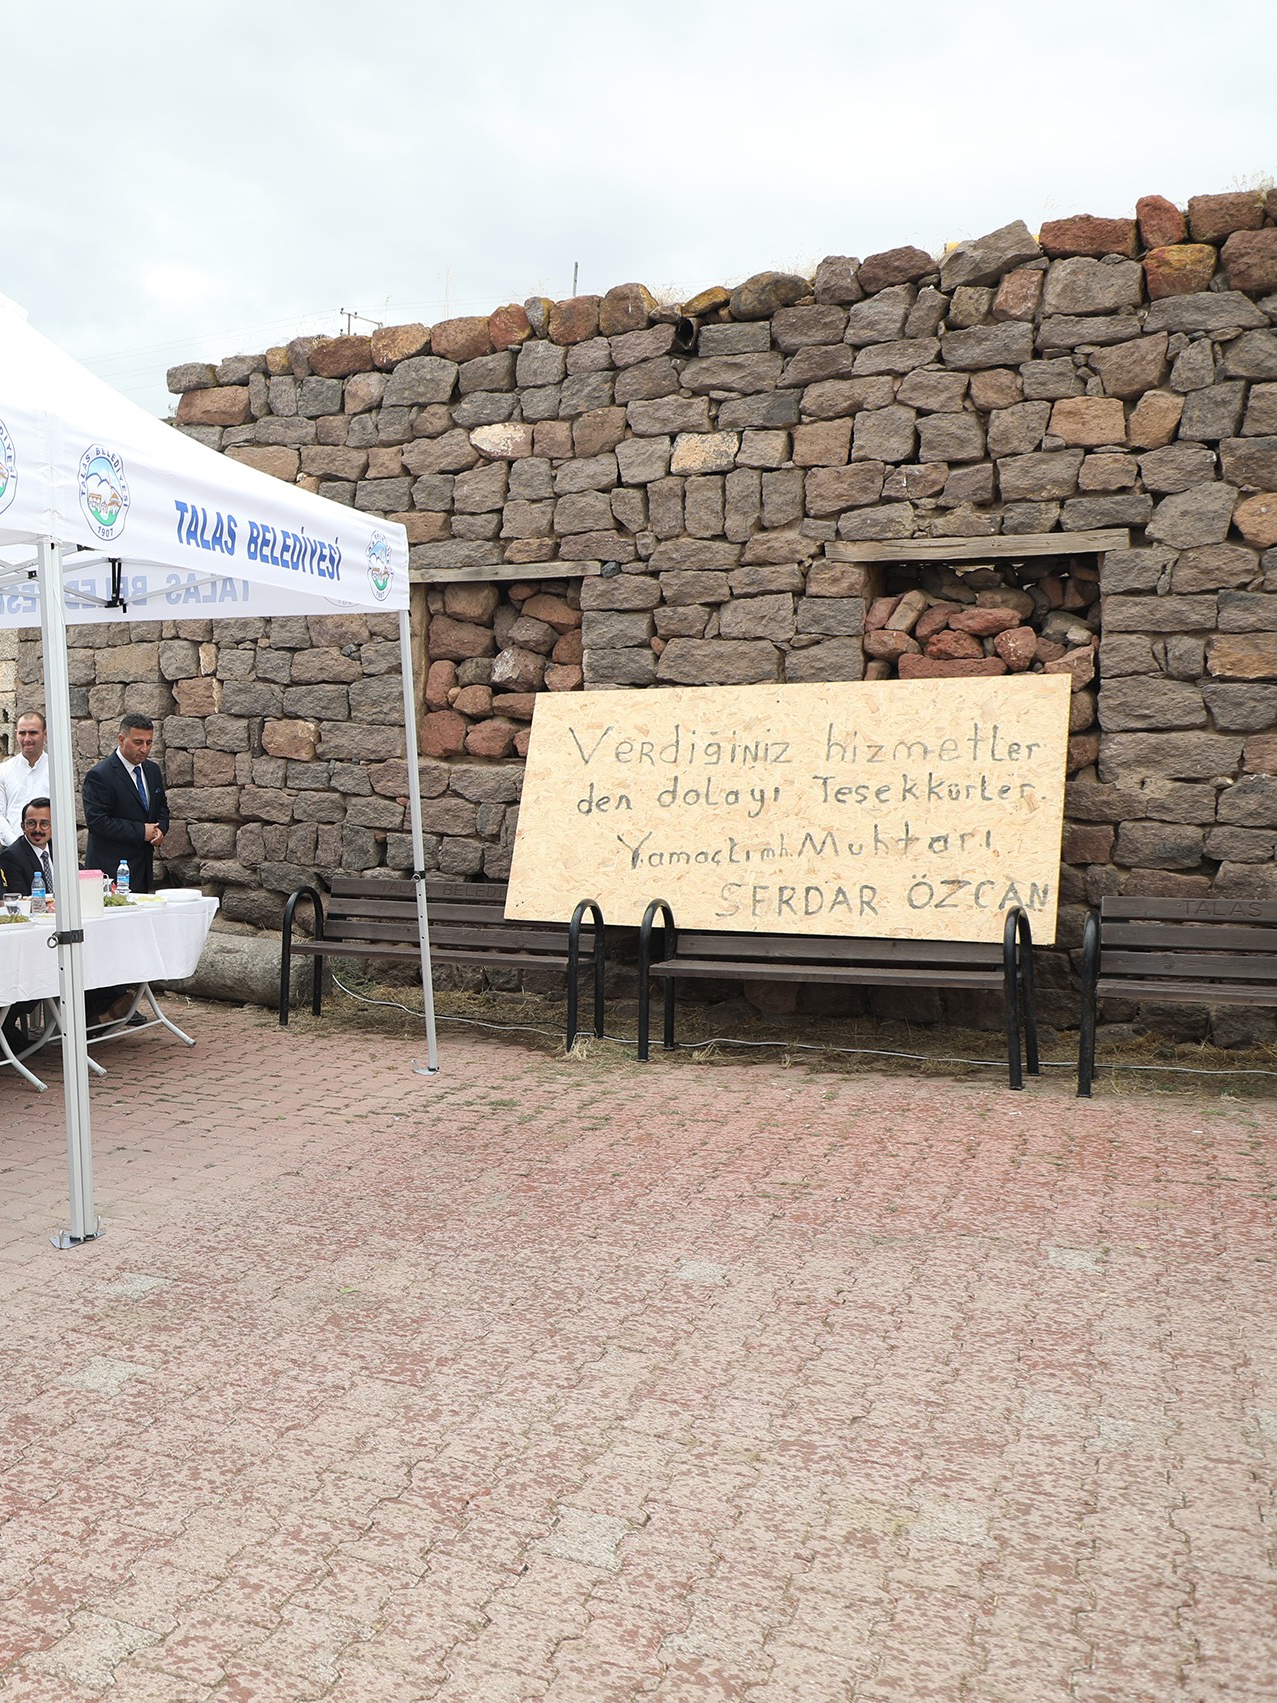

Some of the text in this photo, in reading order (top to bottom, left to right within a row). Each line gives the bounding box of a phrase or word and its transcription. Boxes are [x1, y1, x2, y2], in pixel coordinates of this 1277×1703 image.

[80, 453, 91, 498] TALAS
[97, 525, 114, 538] 1907
[174, 499, 238, 556] TALAS
[247, 520, 342, 581] BELEDİYESİ
[577, 782, 633, 815] den
[714, 873, 1049, 917] SERDAR ÖZCAN
[1182, 899, 1263, 917] TALAS
